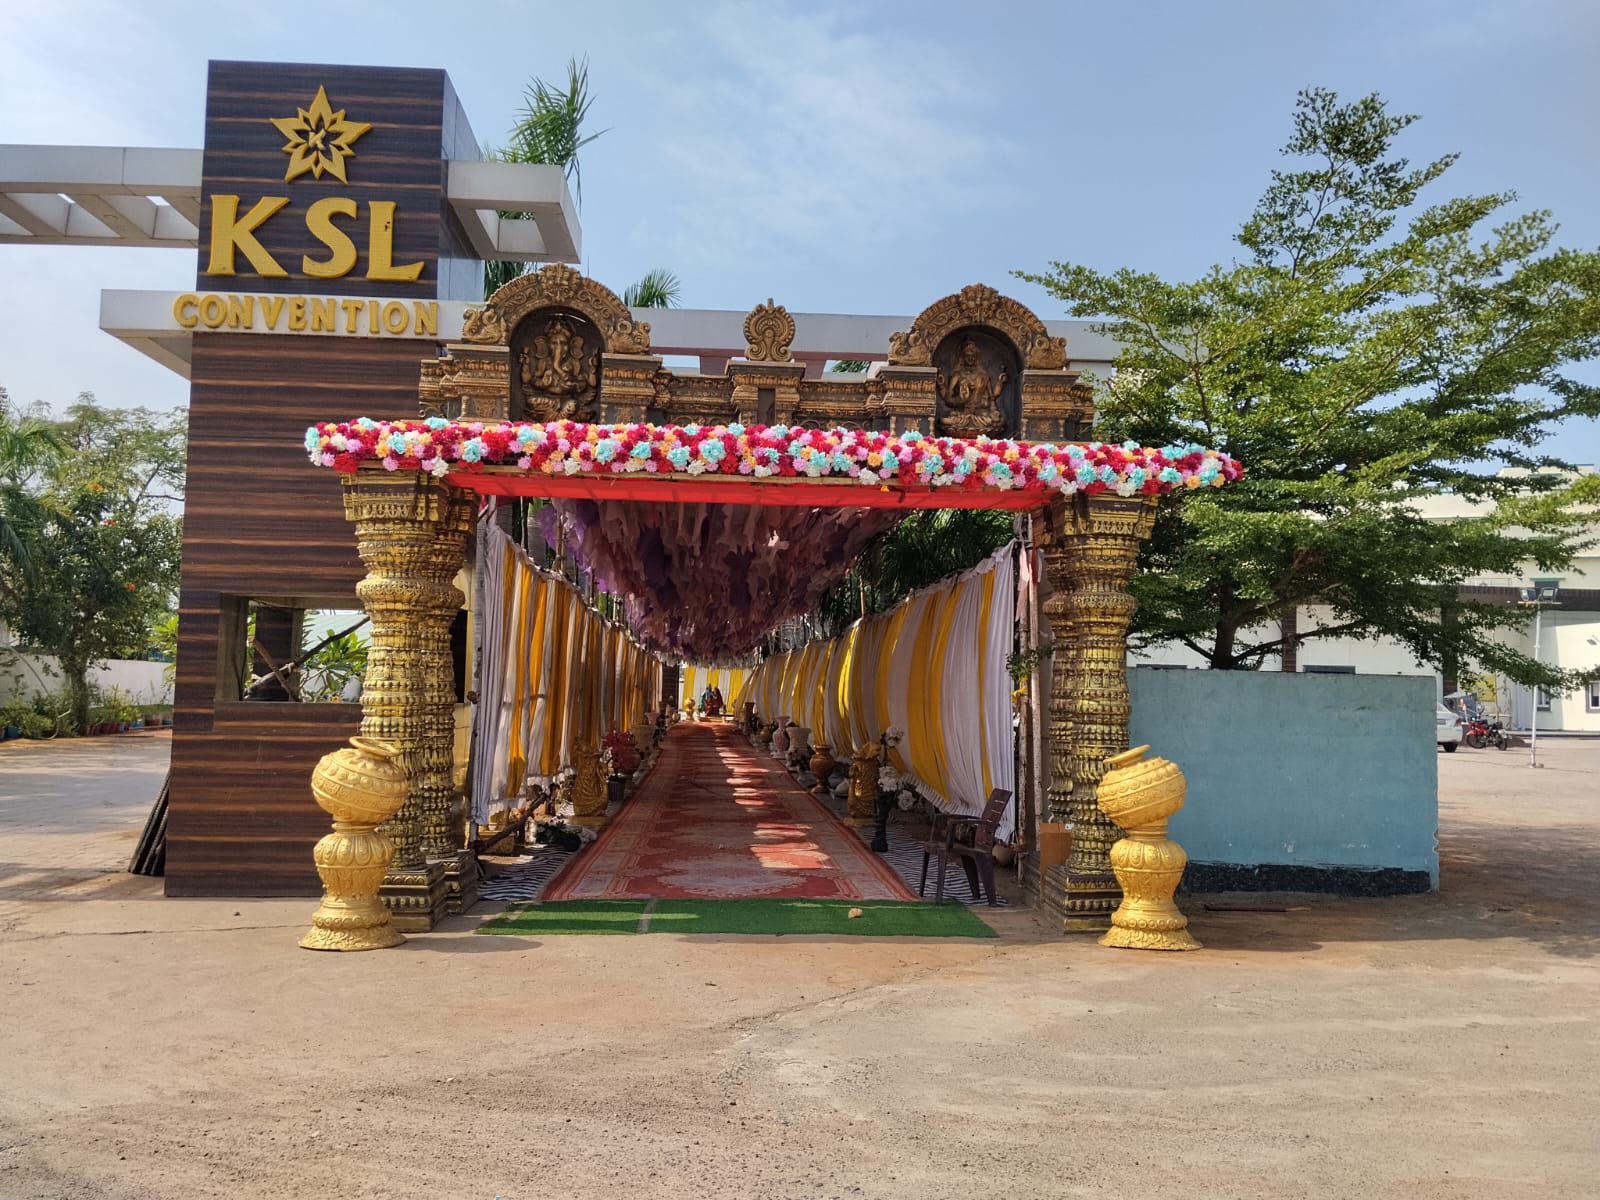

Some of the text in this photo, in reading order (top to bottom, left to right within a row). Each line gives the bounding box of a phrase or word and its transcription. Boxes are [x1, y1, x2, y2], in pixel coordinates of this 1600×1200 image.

[309, 129, 325, 149] K
[207, 194, 425, 281] KSL
[173, 293, 439, 335] CONVENTION
